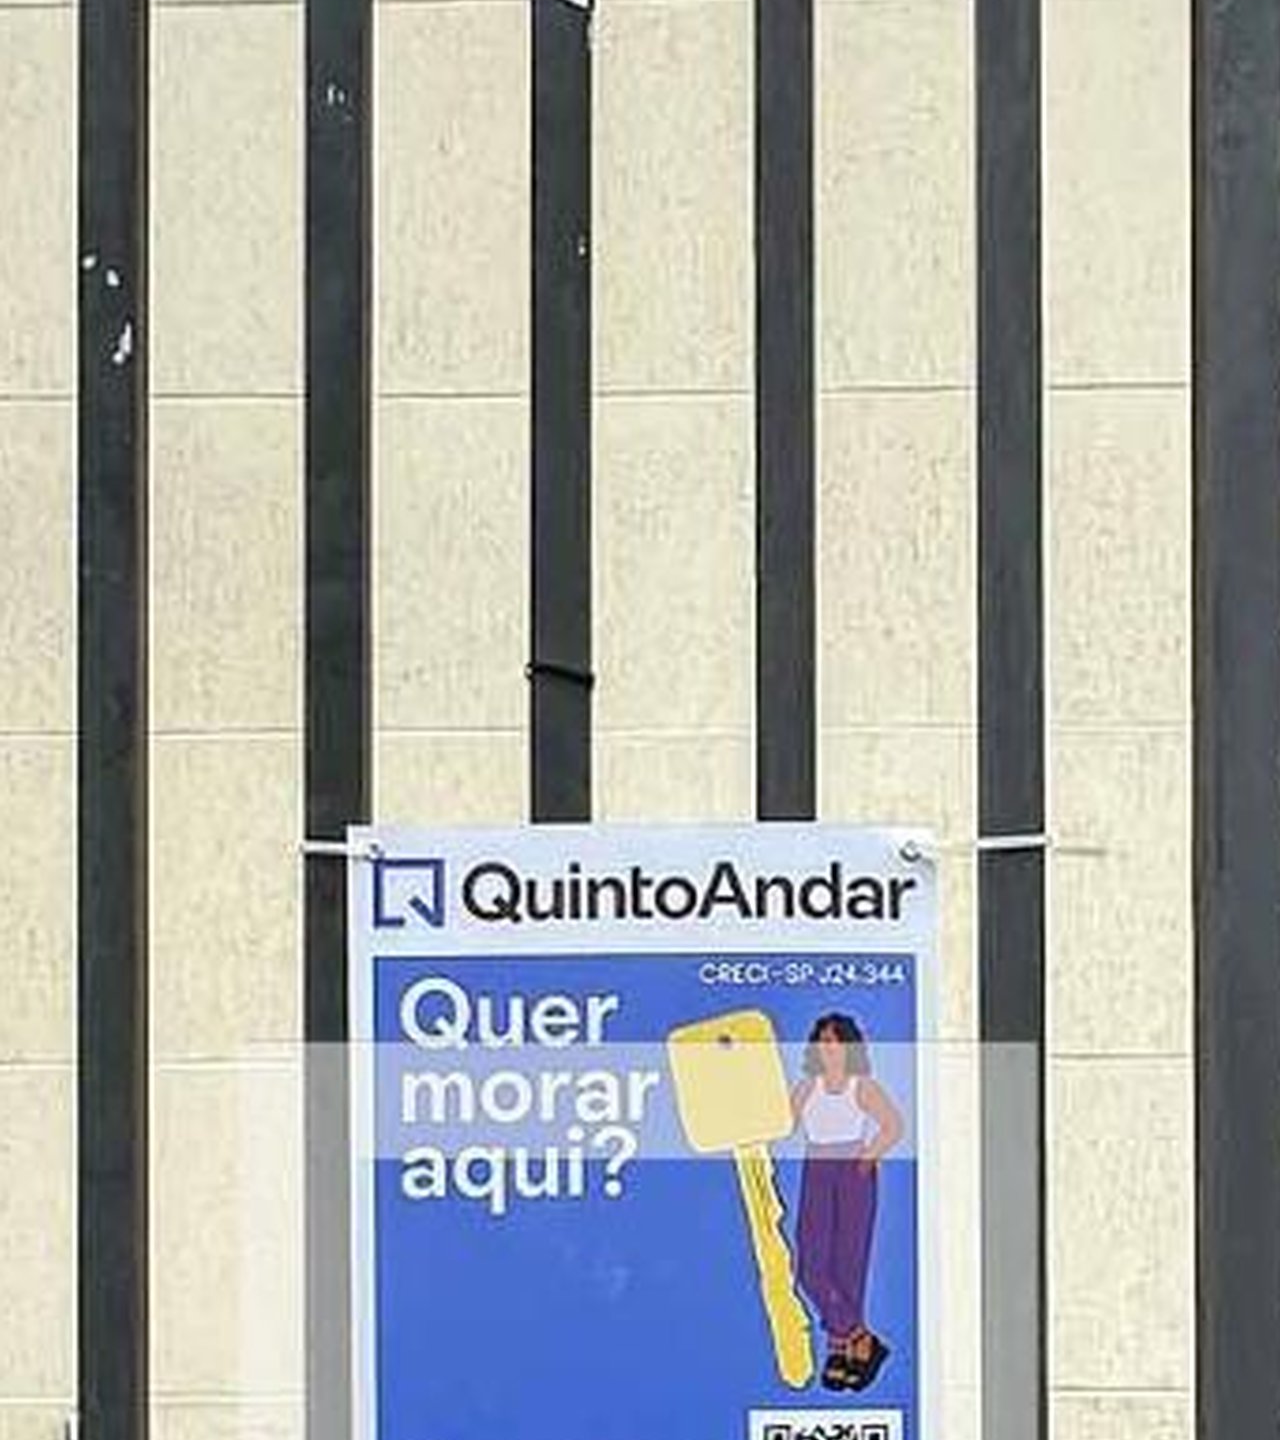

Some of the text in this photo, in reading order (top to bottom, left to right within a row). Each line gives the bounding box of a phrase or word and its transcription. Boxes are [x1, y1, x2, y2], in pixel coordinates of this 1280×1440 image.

[462, 861, 916, 923] QuintoAndar
[400, 977, 618, 1050] Quer
[401, 1069, 660, 1123] morar
[401, 1127, 638, 1216] aqui?
